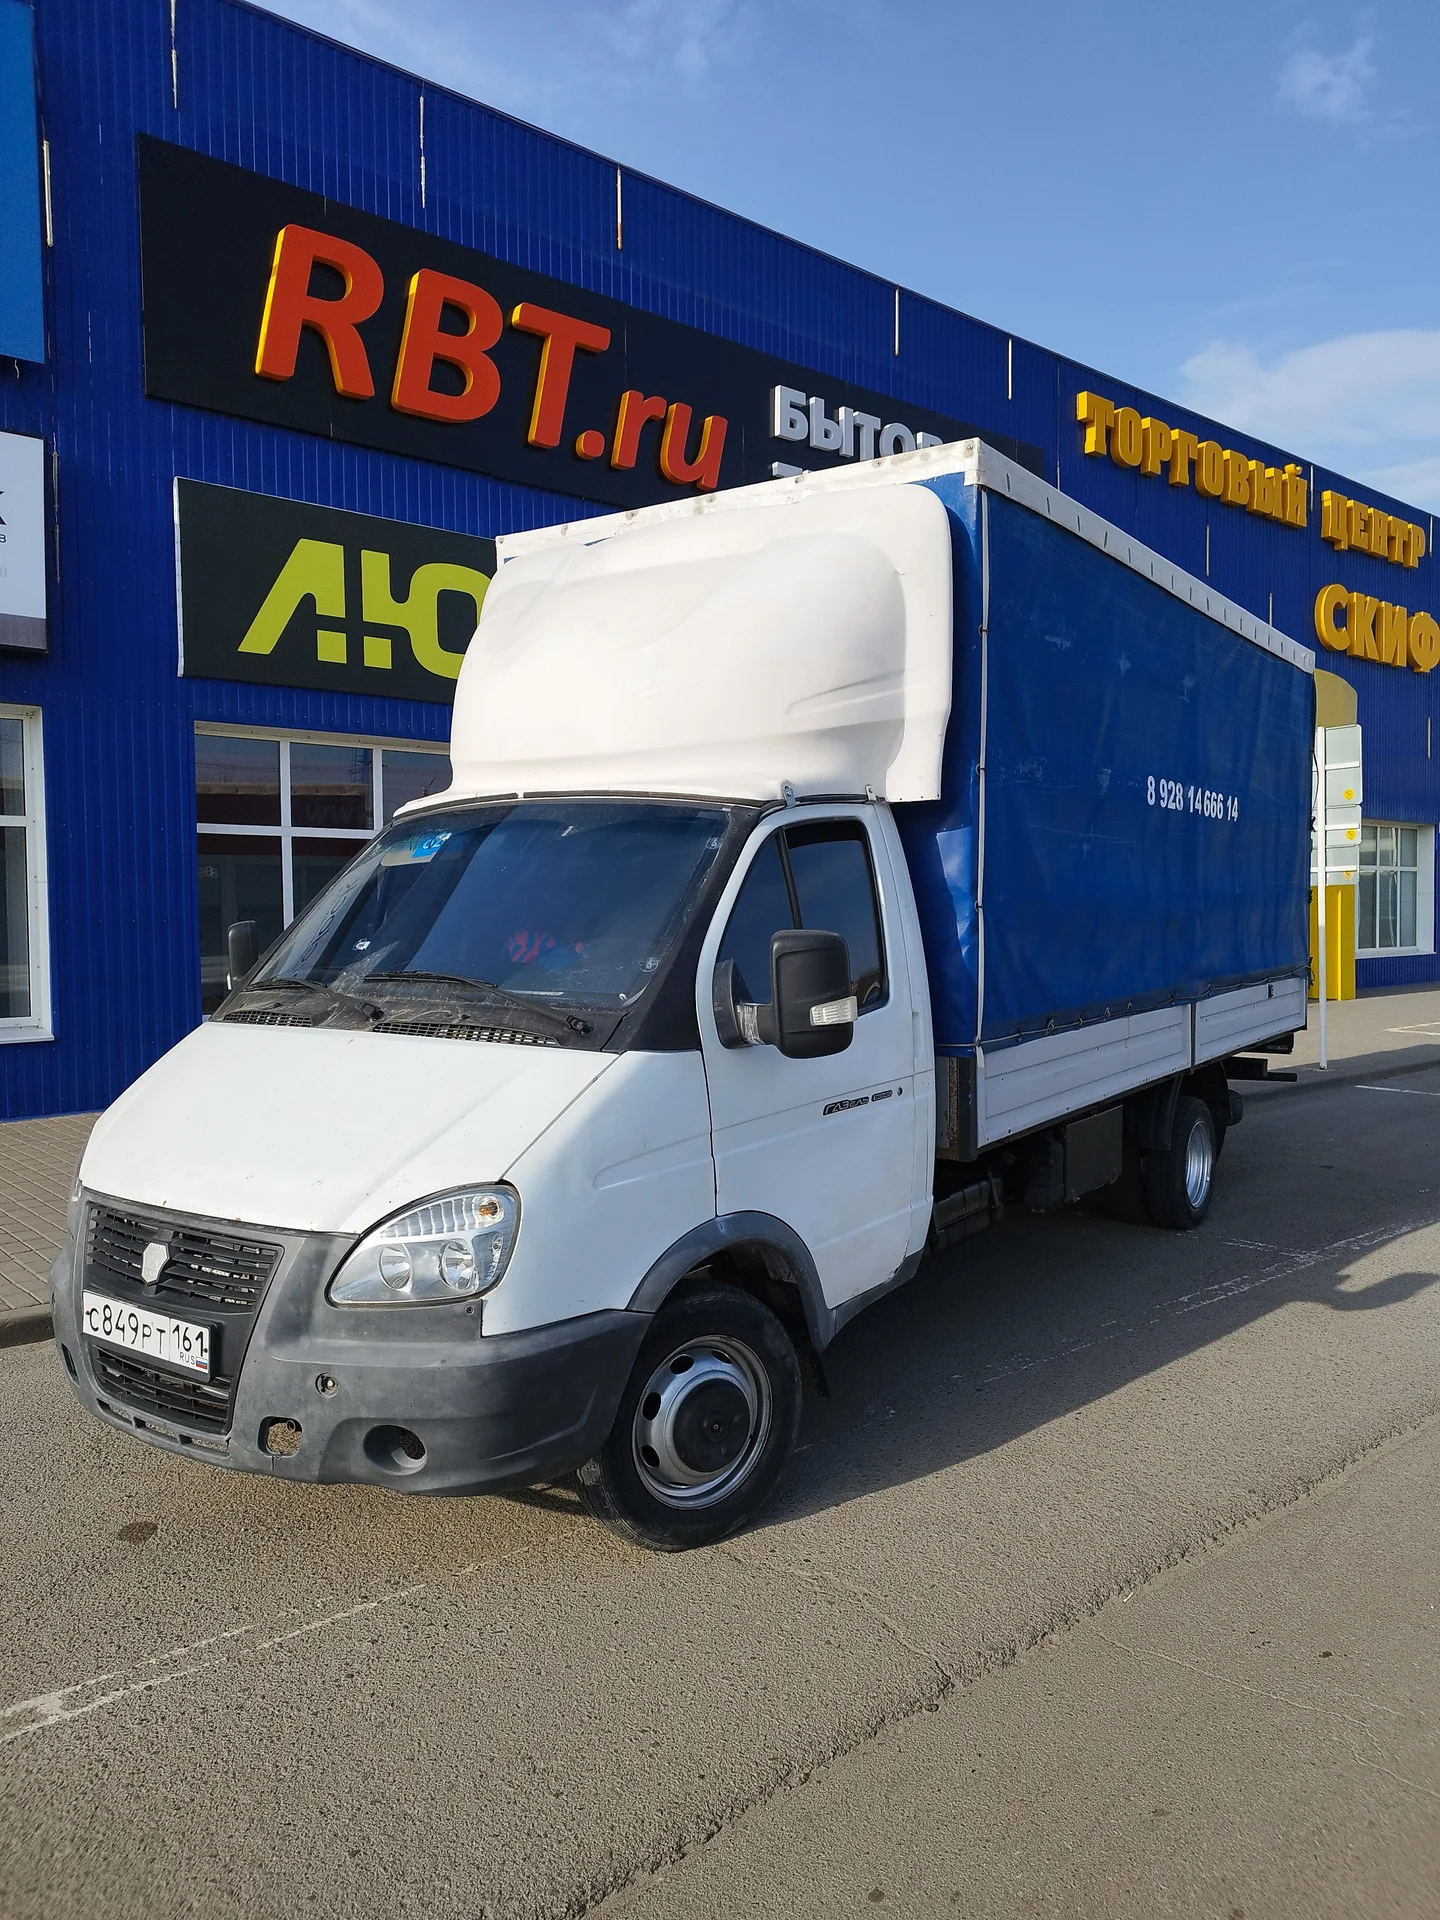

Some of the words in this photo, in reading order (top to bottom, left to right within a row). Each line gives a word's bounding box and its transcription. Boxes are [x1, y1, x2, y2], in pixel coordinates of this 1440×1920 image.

[255, 223, 728, 490] RBT.ru
[1076, 390, 1307, 528] ТОРГОВЫЙ
[1321, 490, 1426, 568] ЦЕНТР
[1314, 583, 1440, 673] СКИФ
[1147, 775, 1156, 806] 8
[1159, 778, 1184, 811] 928
[1226, 795, 1239, 822] 14
[172, 1324, 205, 1357] 161
[179, 1351, 196, 1366] RUS
